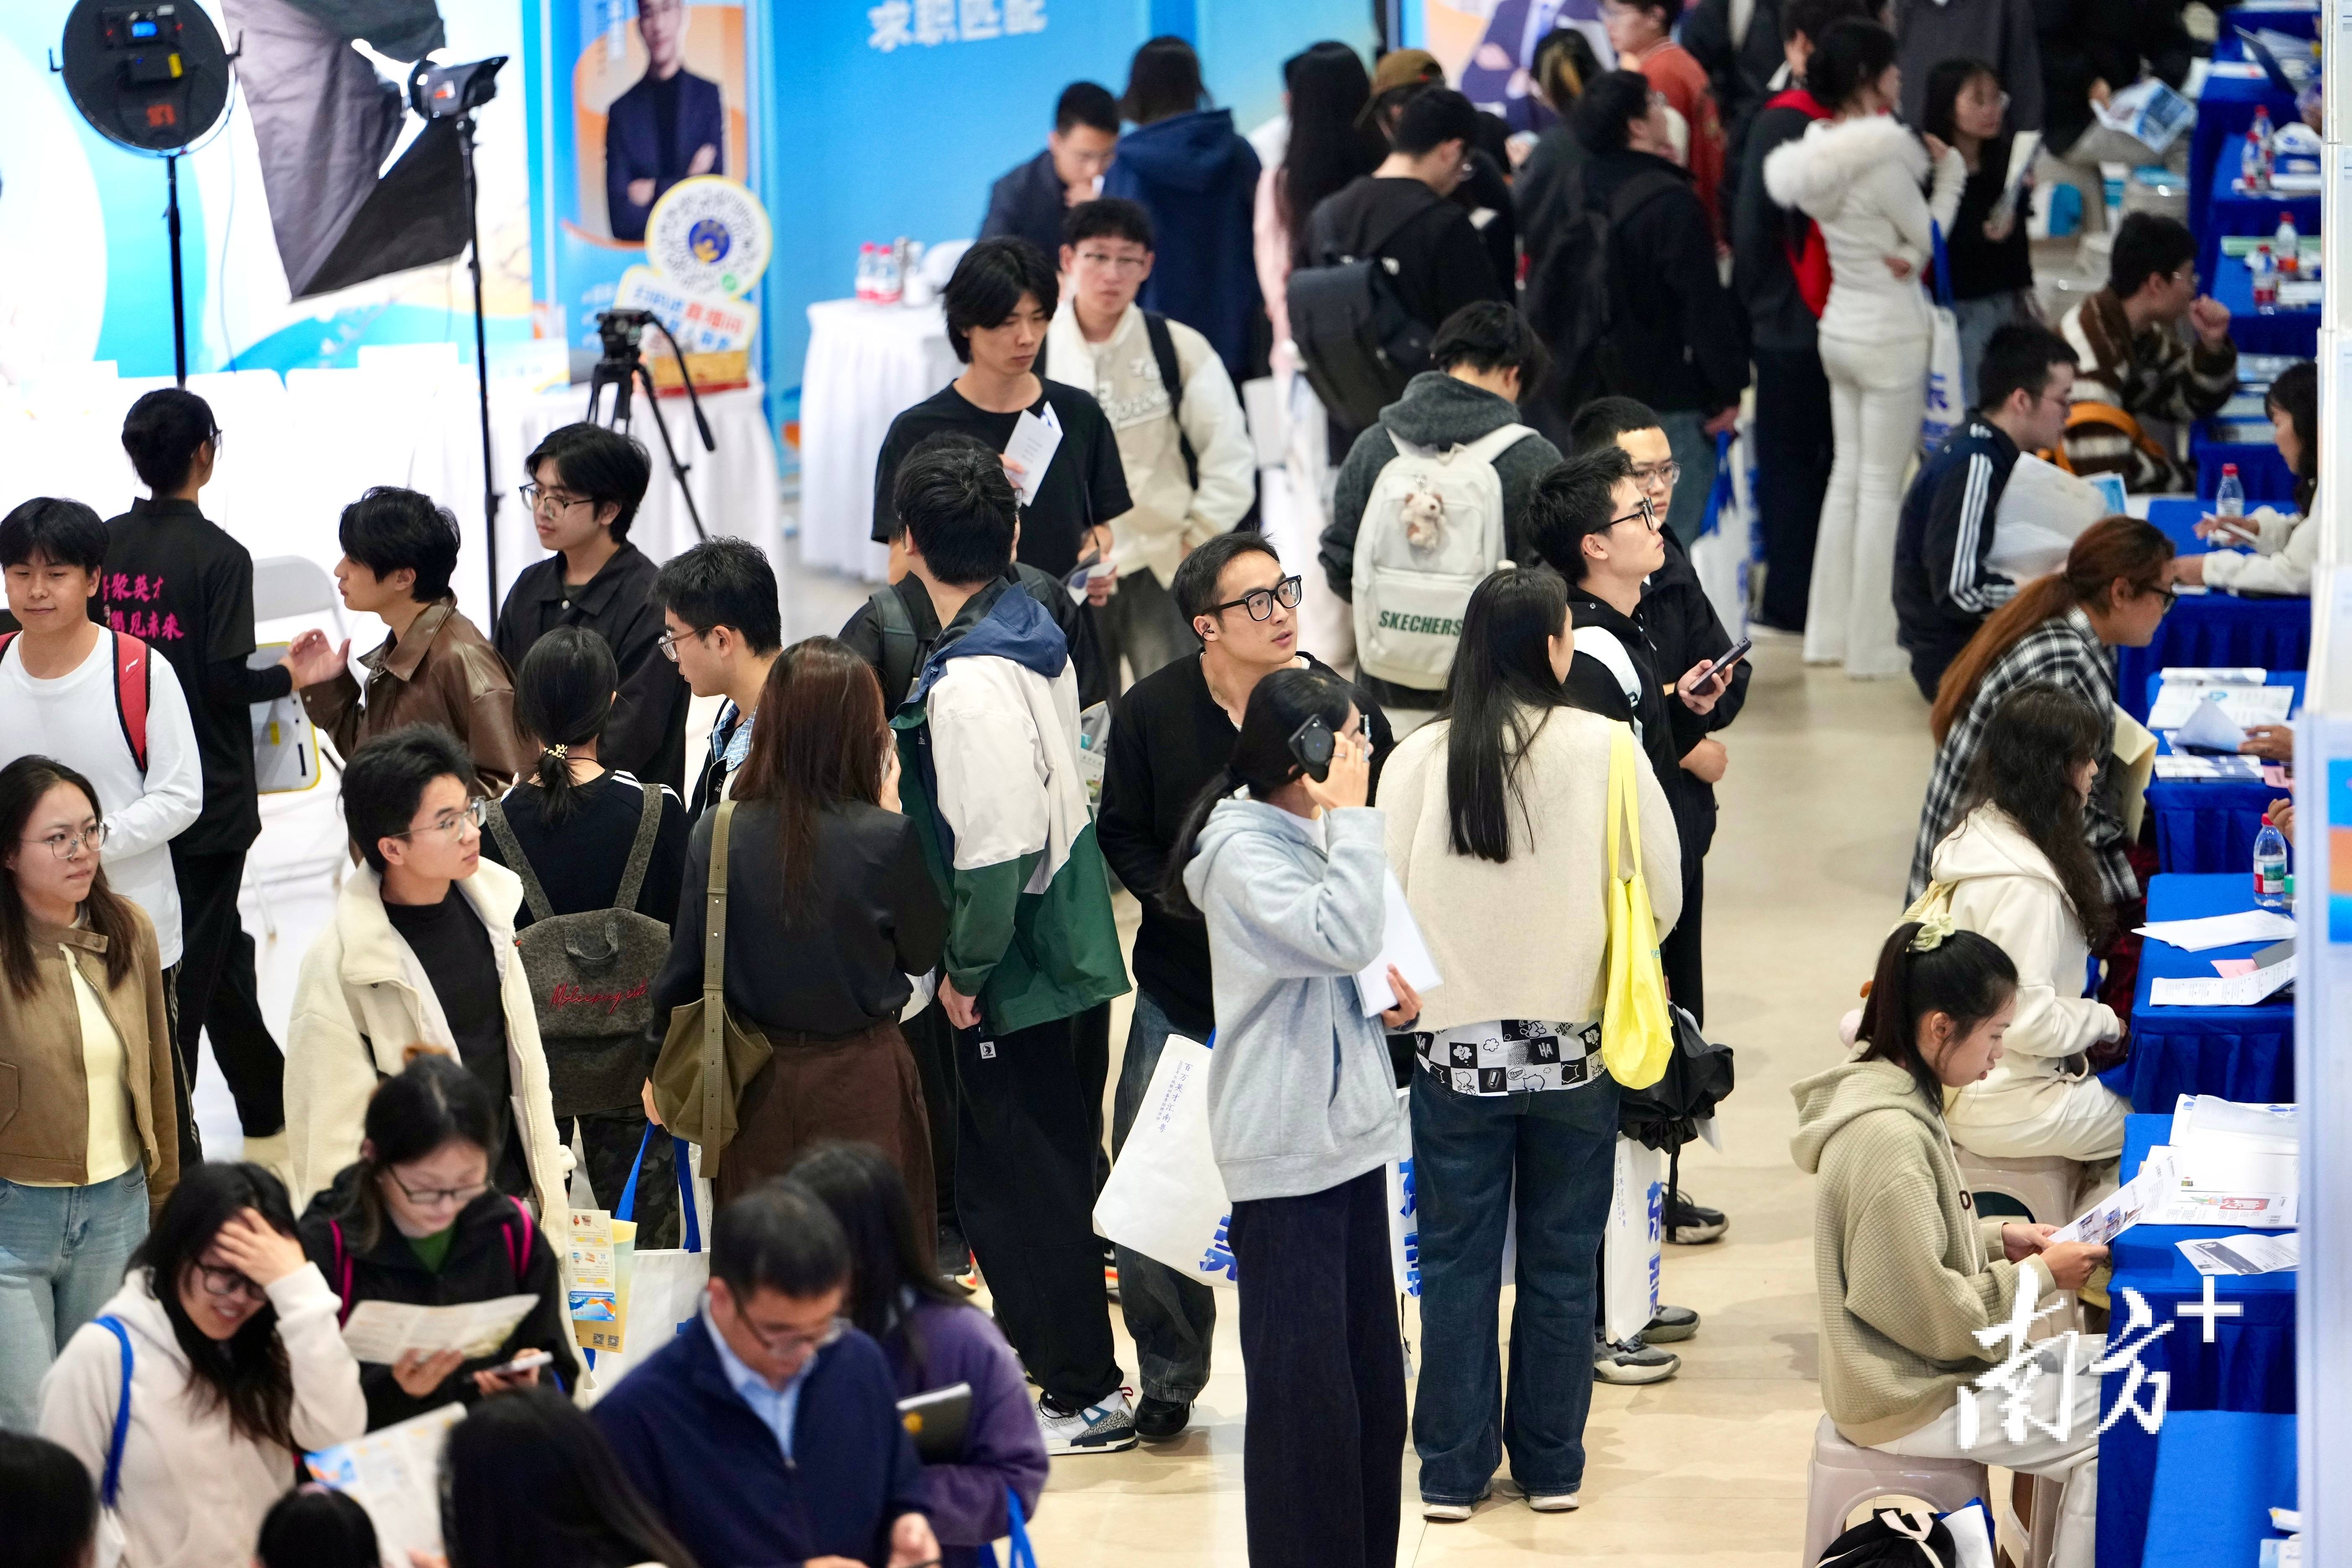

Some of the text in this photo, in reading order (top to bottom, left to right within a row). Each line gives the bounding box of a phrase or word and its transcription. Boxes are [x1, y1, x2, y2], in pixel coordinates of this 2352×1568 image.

[1378, 611, 1463, 636] SKECHERS
[1416, 1034, 1426, 1051] HA
[1538, 1042, 1553, 1058] HA
[1158, 1063, 1193, 1133] 百万英才汇南粤
